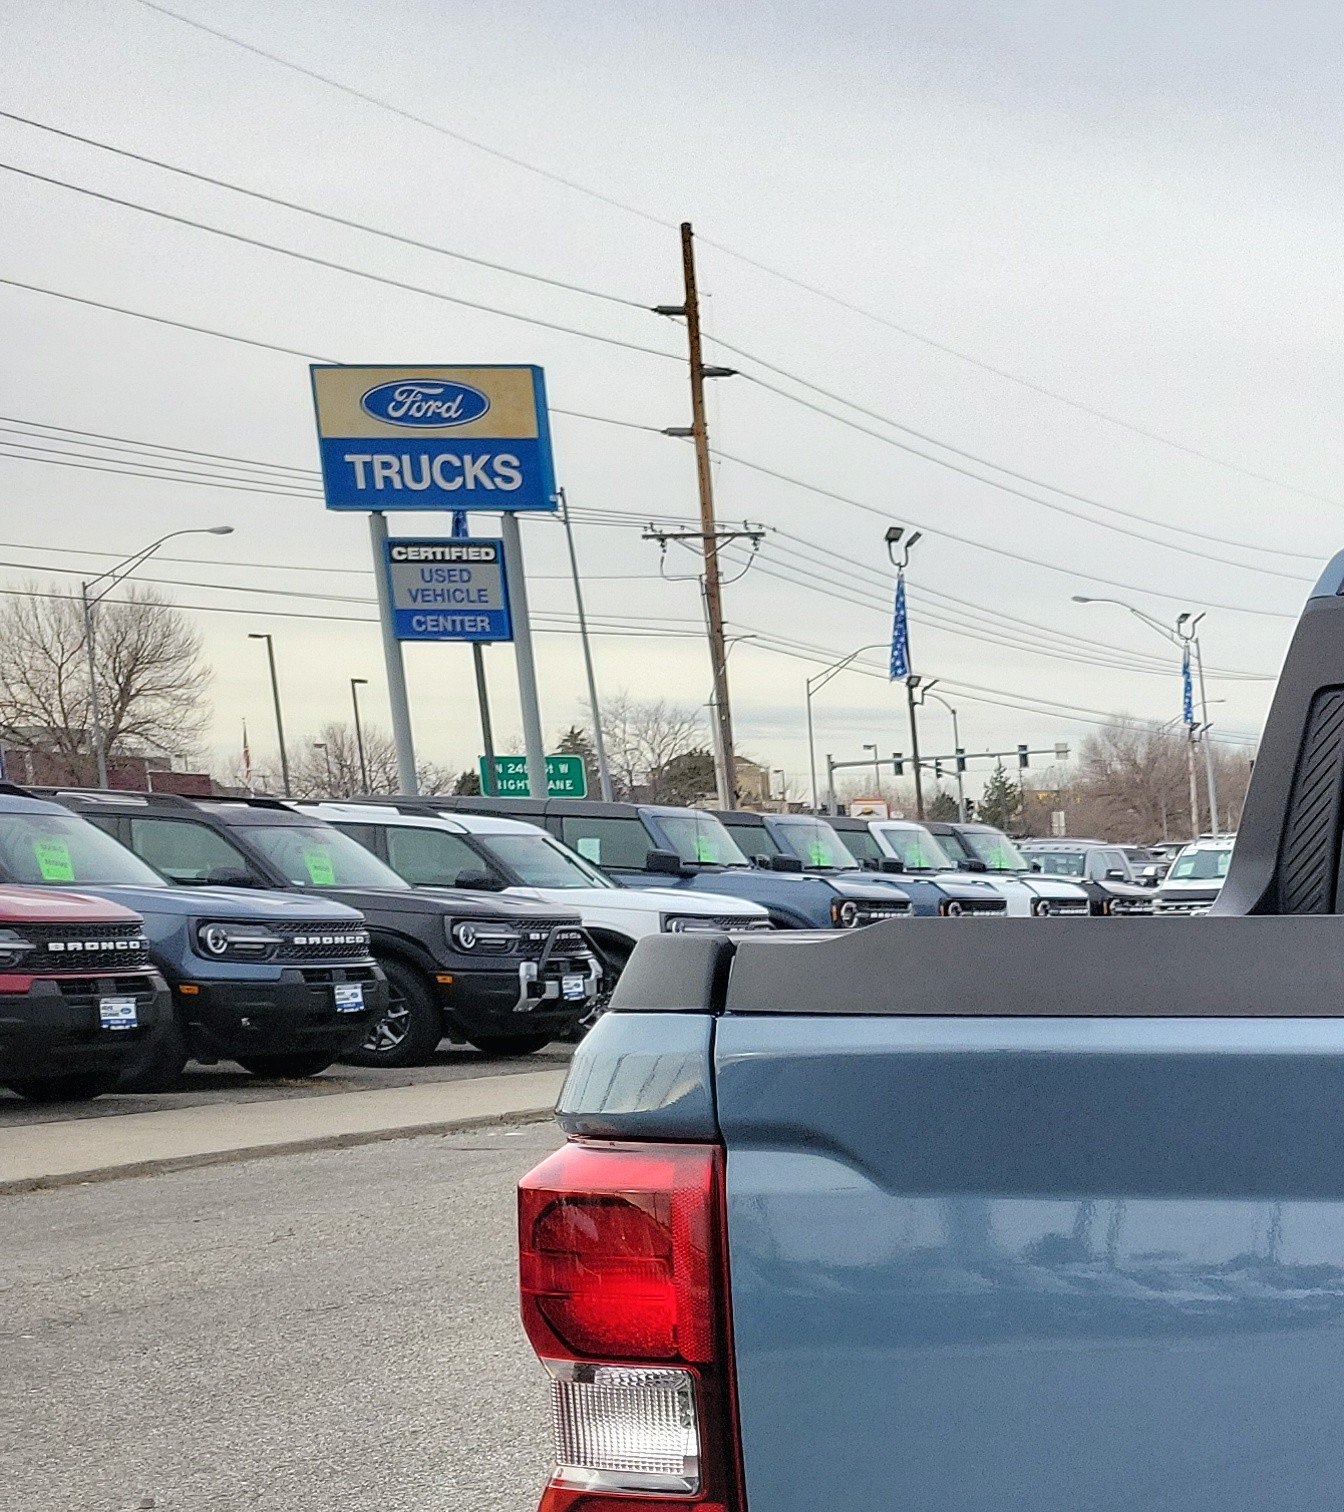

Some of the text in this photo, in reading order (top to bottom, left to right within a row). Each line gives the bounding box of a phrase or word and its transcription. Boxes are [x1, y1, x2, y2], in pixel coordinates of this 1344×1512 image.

[387, 385, 464, 420] Ford
[344, 454, 522, 492] TRUCKS
[391, 546, 496, 562] CERTIFIED
[420, 568, 472, 584] USED
[407, 587, 489, 604] VEHICLE
[412, 614, 491, 633] CENTER
[547, 779, 574, 791] ANE
[48, 941, 141, 951] BRONCO
[294, 936, 365, 945] BRONCO
